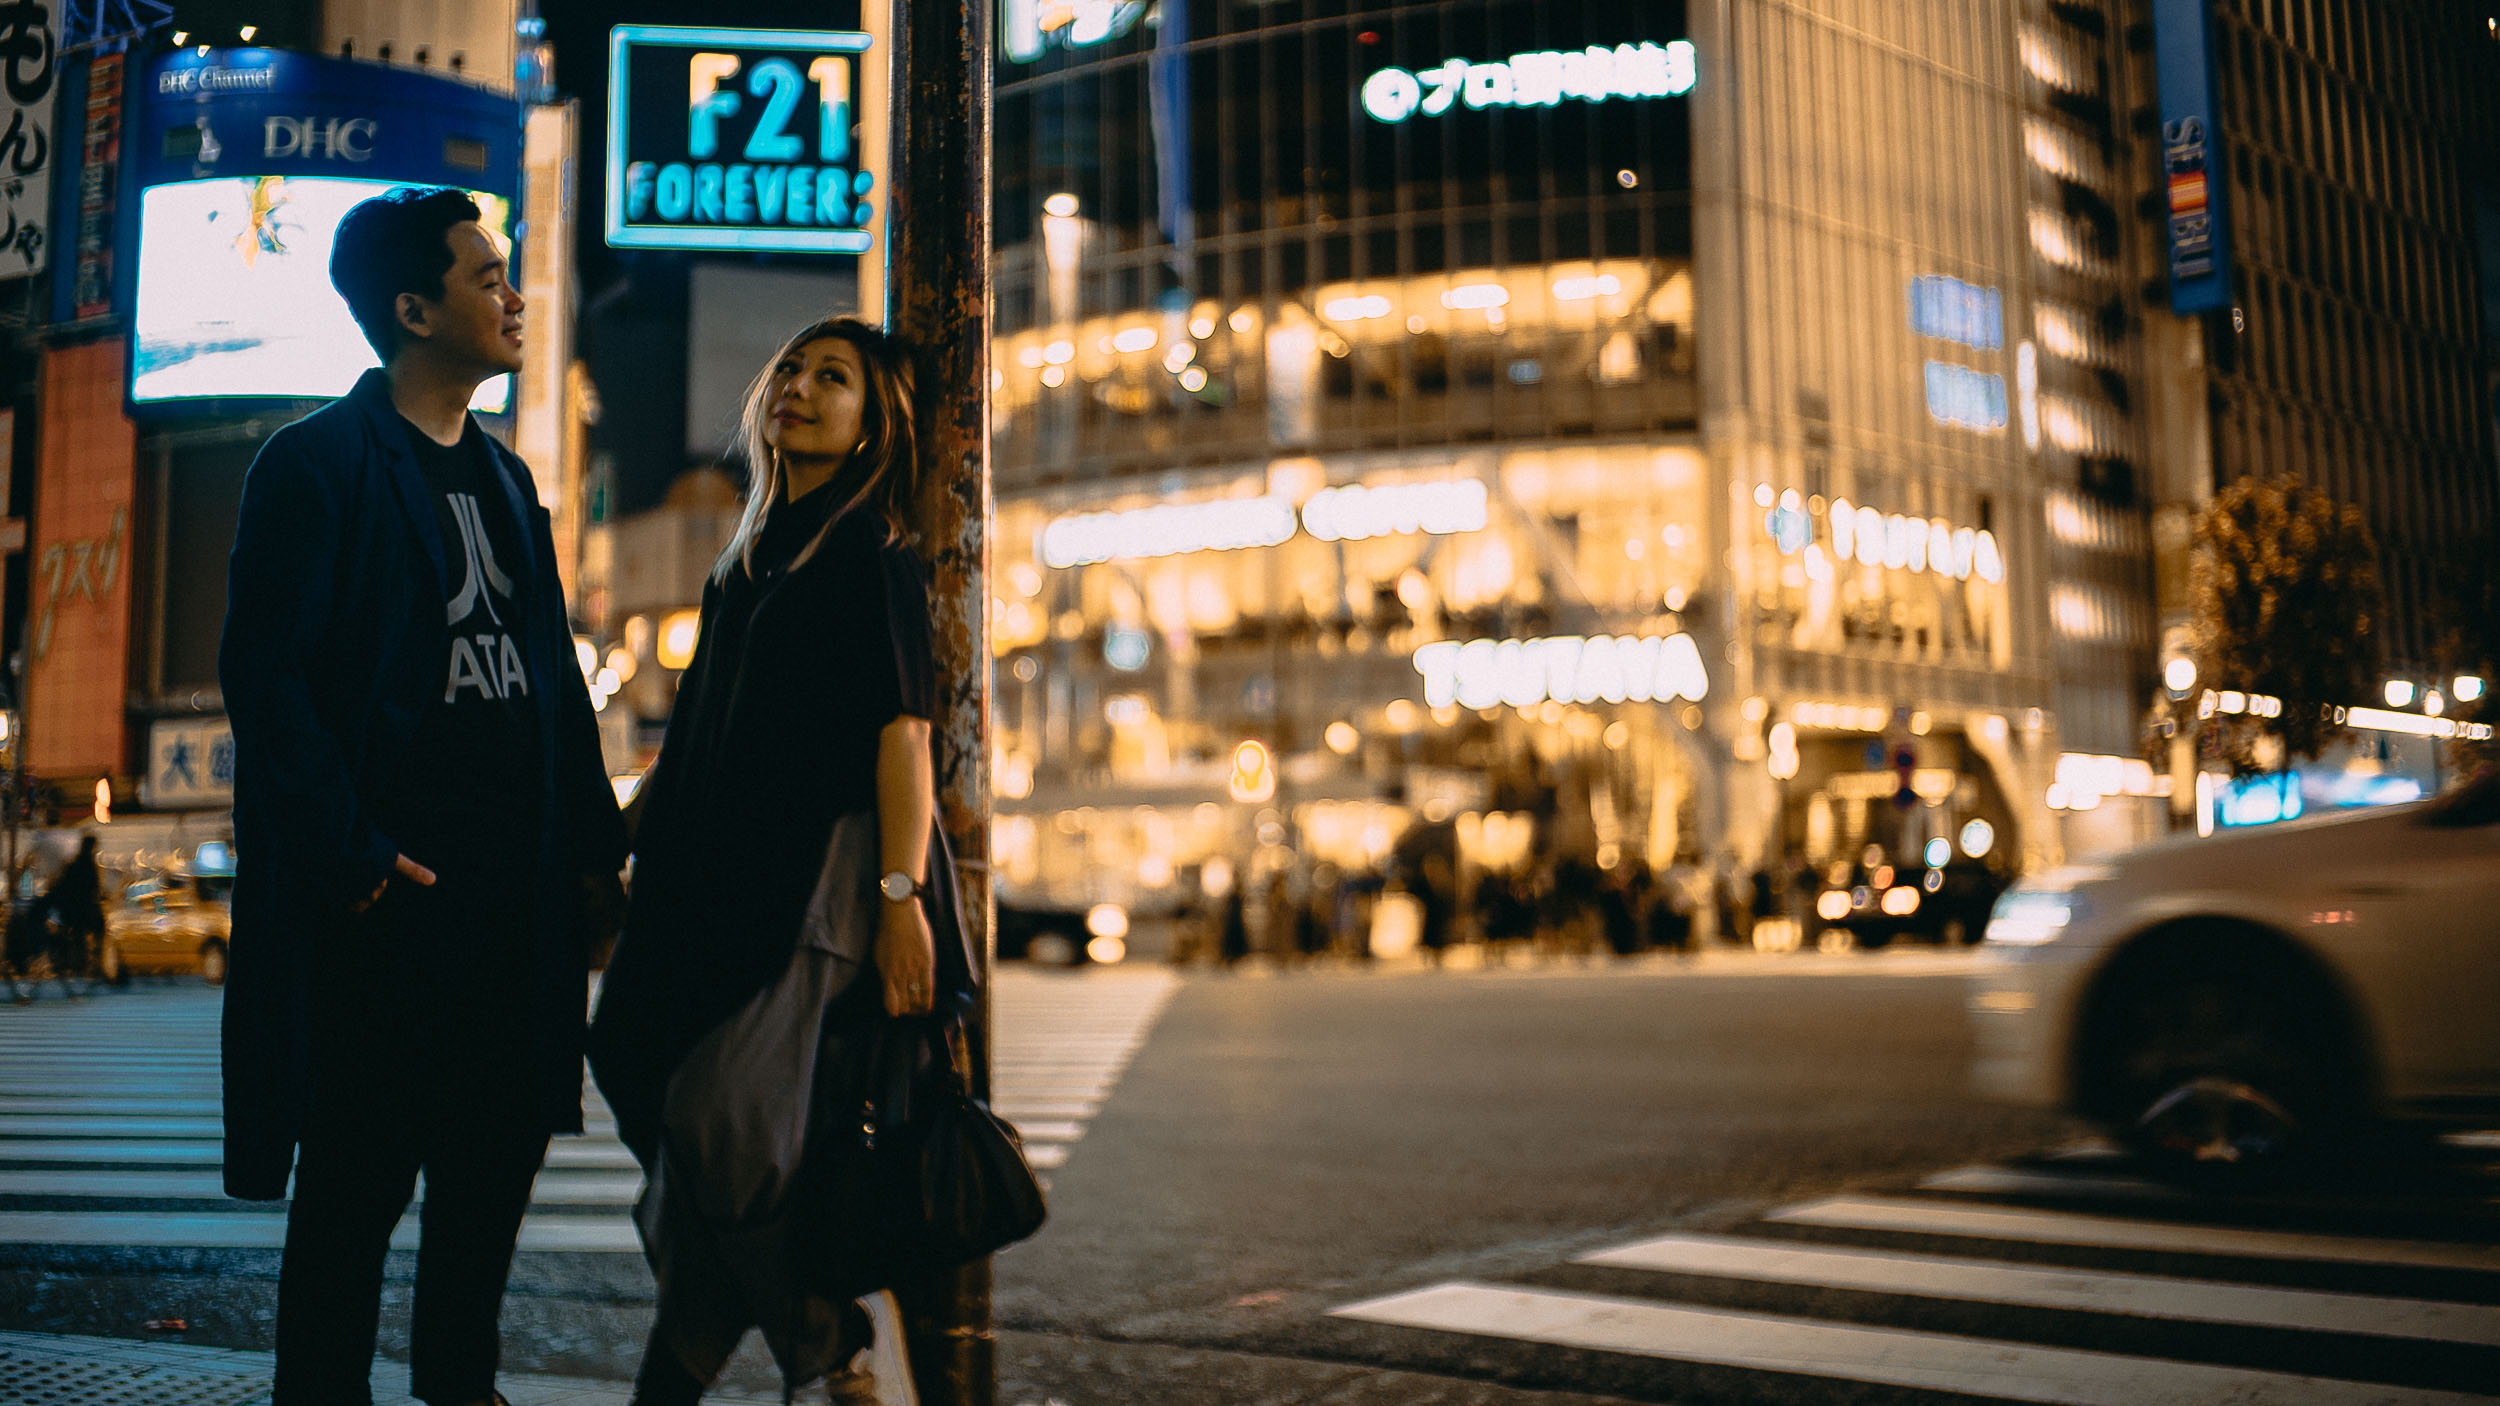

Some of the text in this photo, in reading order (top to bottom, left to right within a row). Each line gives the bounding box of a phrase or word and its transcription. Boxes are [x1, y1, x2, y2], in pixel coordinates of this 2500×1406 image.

[159, 64, 276, 94] DHC Channel
[689, 52, 850, 163] F21
[264, 115, 377, 163] DHC
[2163, 115, 2215, 279] SEIBU
